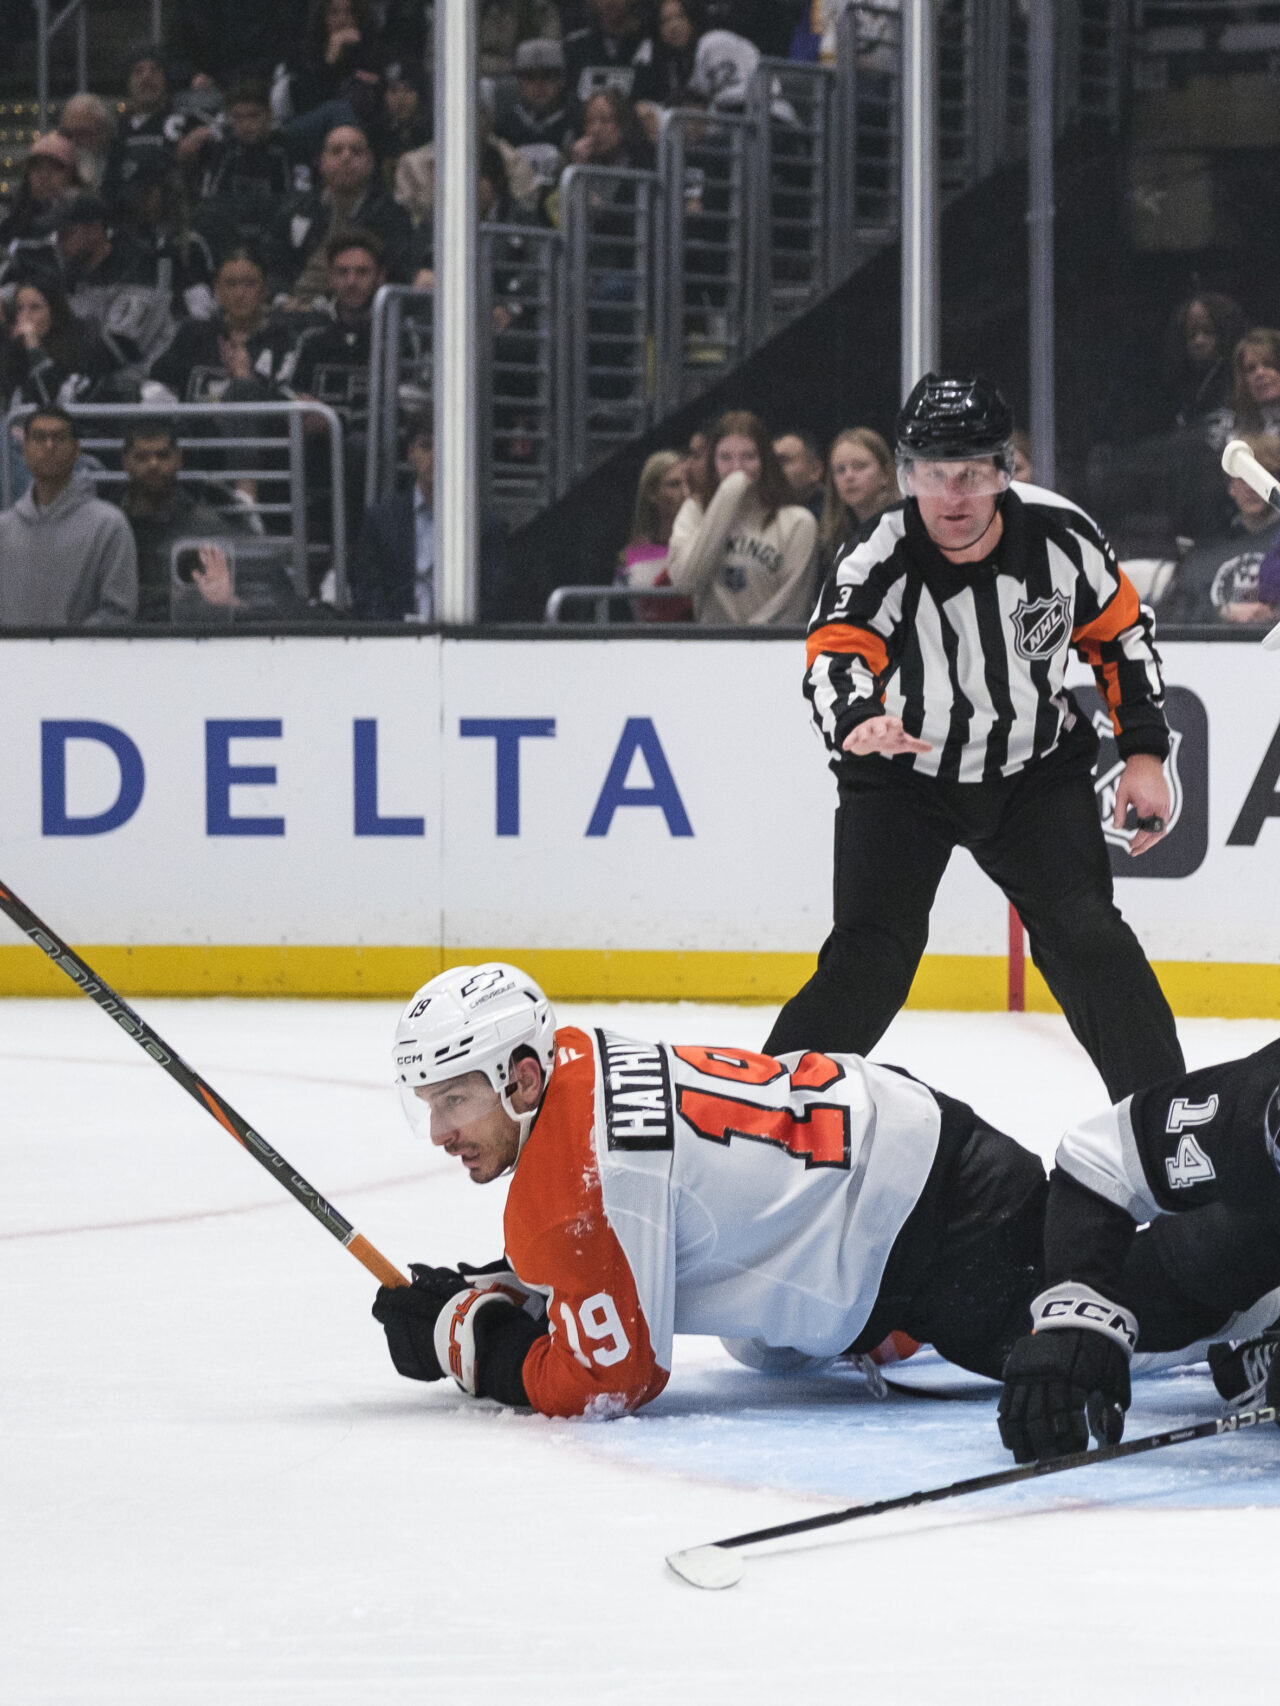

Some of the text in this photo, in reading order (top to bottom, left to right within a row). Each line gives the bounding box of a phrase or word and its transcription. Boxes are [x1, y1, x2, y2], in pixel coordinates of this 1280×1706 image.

[835, 586, 853, 610] 3
[1030, 611, 1063, 653] NHL
[40, 717, 696, 838] DELTA
[409, 998, 432, 1019] 19
[470, 981, 516, 1010] CHEVROLET
[397, 1054, 423, 1066] CCM
[672, 1044, 851, 1171] 19
[1165, 1094, 1219, 1189] 14
[560, 1292, 630, 1367] 19
[1042, 1300, 1136, 1347] CCM
[1216, 1407, 1276, 1434] CCM
